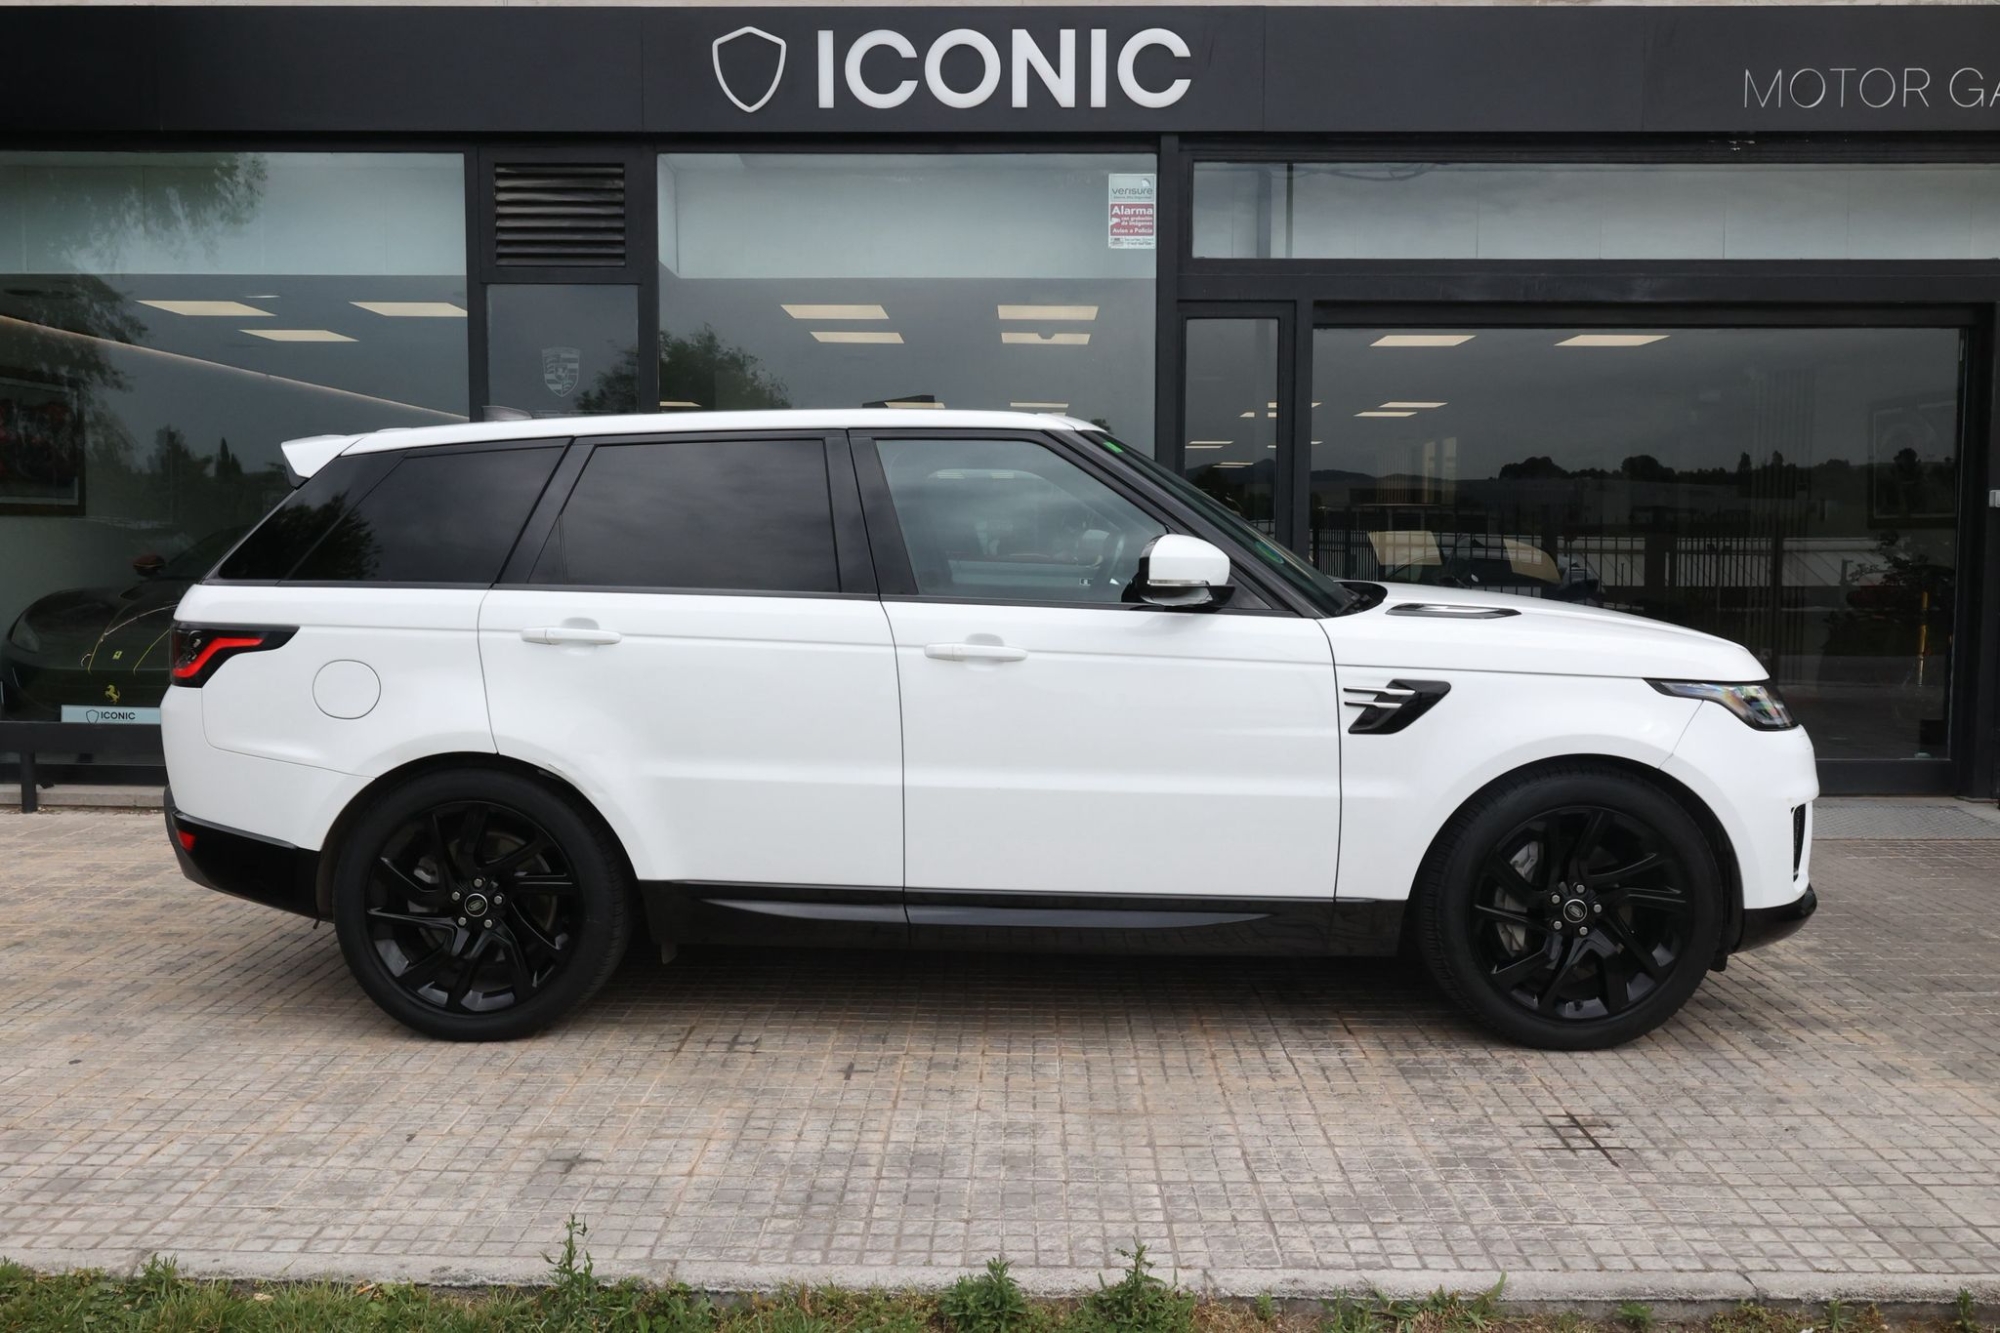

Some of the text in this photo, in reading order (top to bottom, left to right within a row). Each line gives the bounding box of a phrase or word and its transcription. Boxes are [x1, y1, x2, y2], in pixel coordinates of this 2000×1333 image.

[817, 27, 1192, 110] ICONIC
[1743, 67, 1931, 109] MOTOR
[1111, 187, 1153, 195] verisure
[1111, 205, 1153, 215] Alarma
[100, 711, 136, 720] ICONIC
